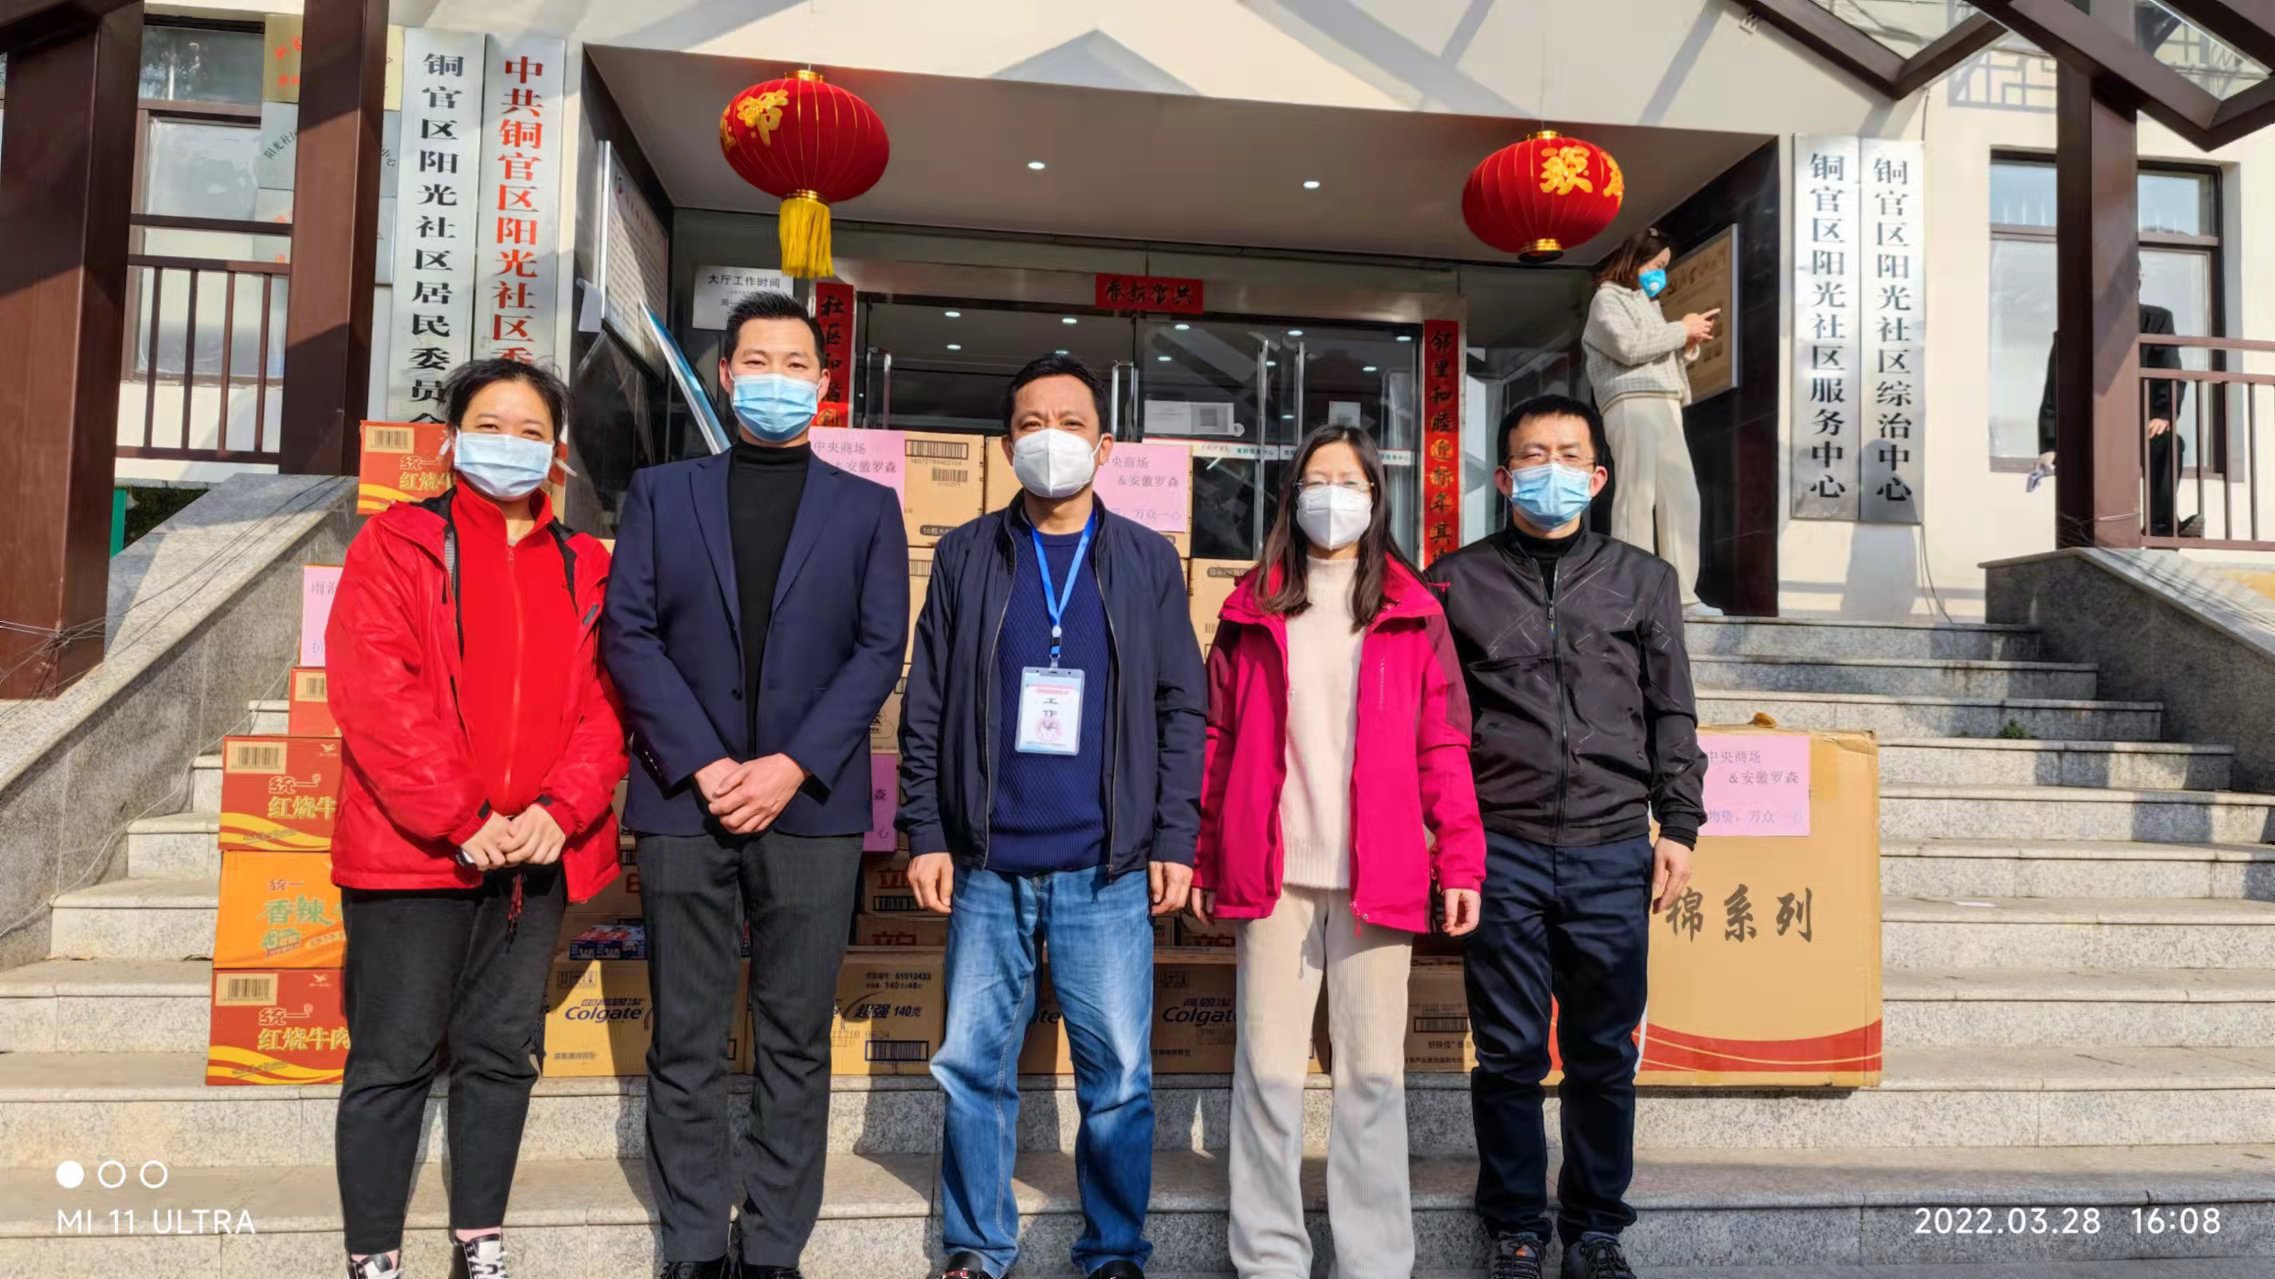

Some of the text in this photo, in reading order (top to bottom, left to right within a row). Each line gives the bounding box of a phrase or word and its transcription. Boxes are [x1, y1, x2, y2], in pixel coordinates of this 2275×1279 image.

[707, 273, 781, 288] 大厅工作时间
[1809, 153, 1847, 498] 铜官区阳光社区服务中心
[1873, 157, 1912, 501] 铜官区阳光社区综治中心
[814, 441, 866, 455] 中央商场
[268, 776, 320, 794] 统一
[1665, 883, 1813, 943] 棉系列
[258, 1006, 312, 1026] 统一
[564, 1006, 642, 1024] Colgate
[257, 1026, 350, 1052] 红烧牛肉
